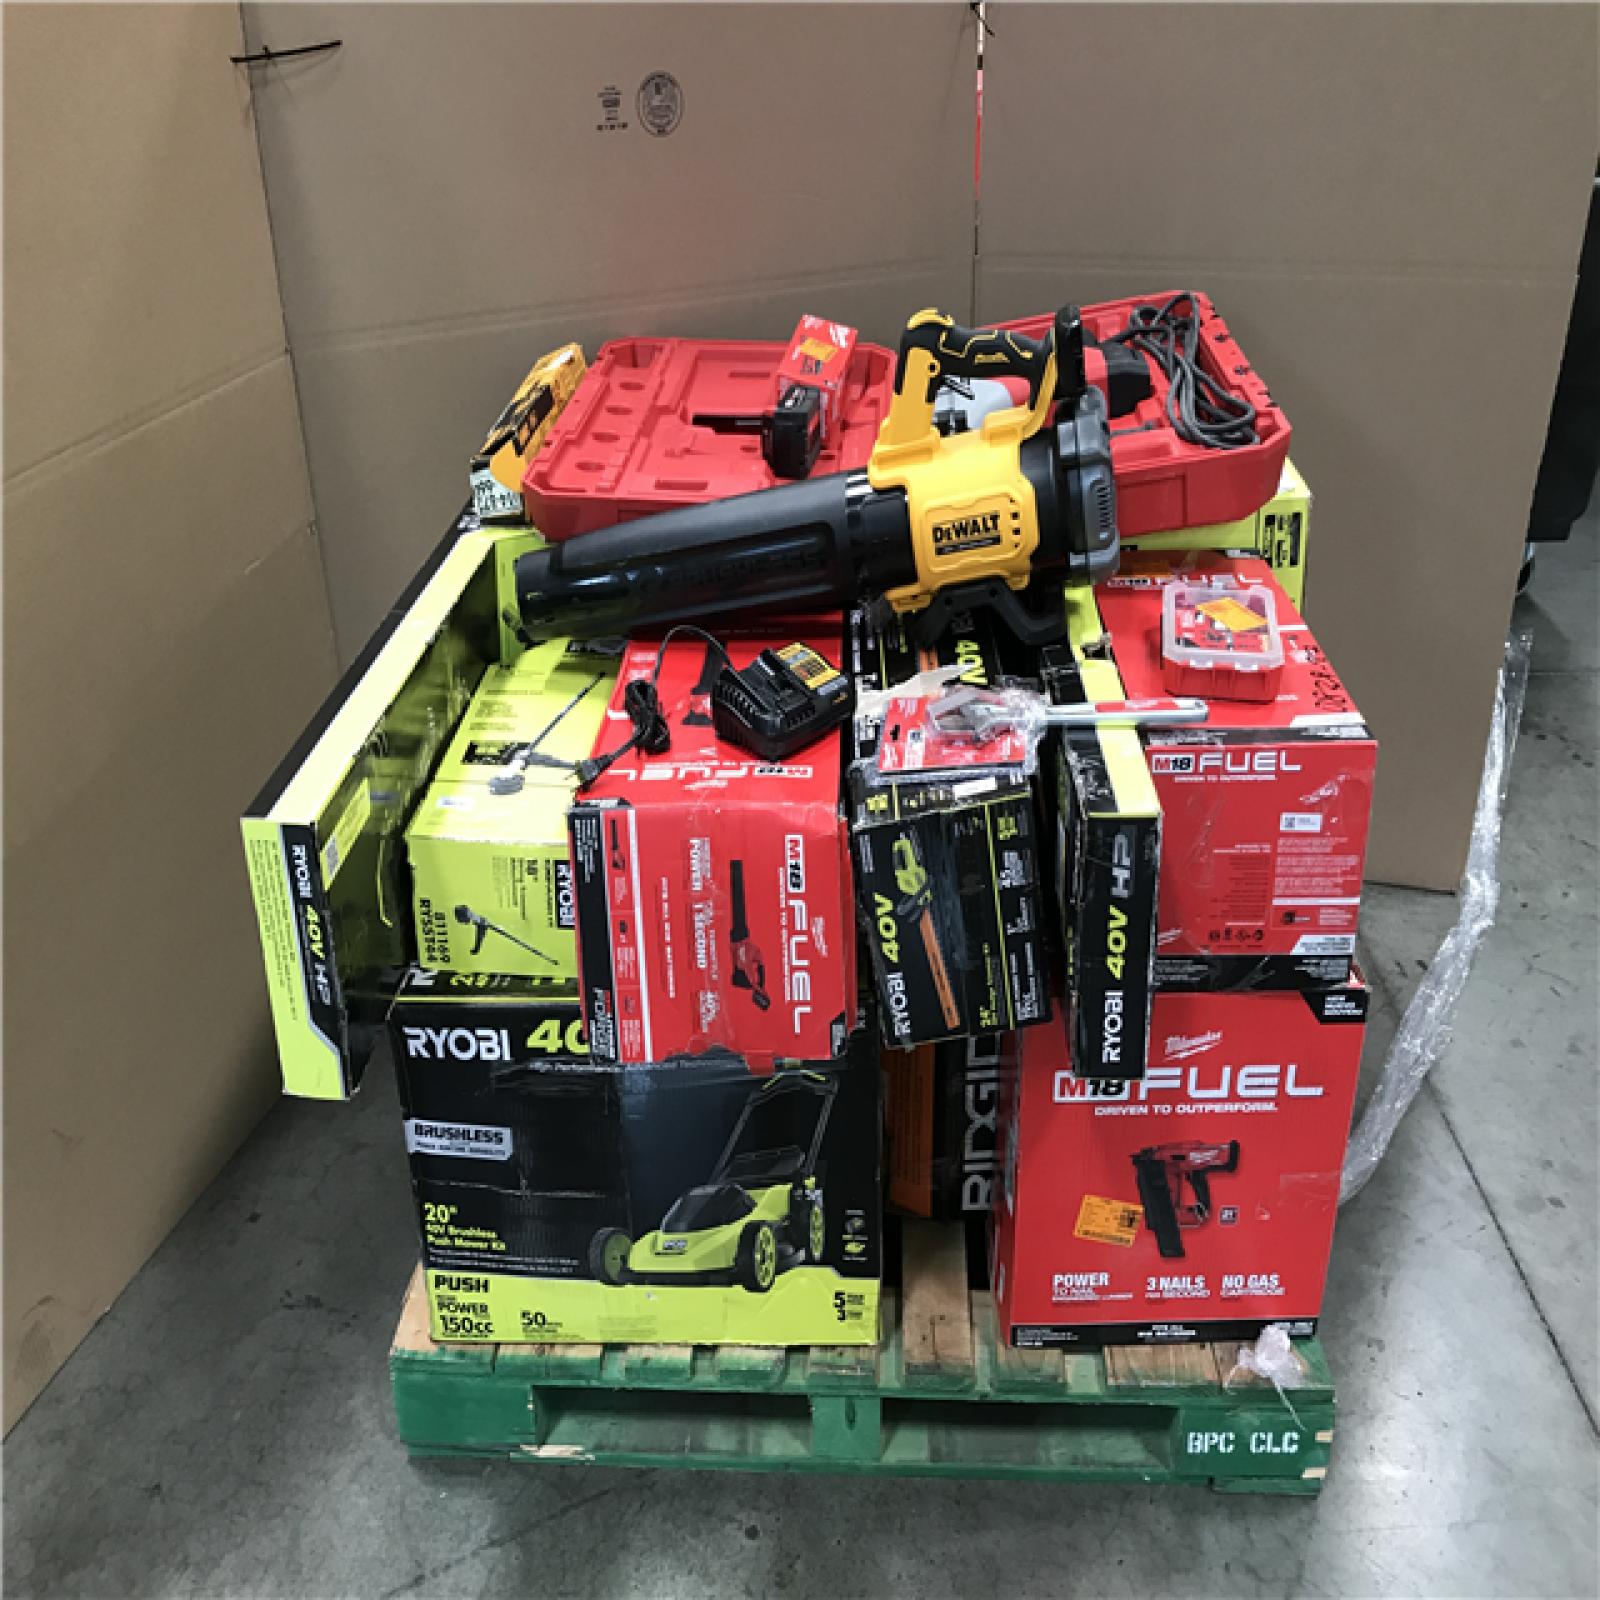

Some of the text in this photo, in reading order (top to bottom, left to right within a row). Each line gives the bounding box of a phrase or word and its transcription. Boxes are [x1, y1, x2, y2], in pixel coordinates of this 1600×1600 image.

[1153, 750, 1302, 772] M18 FUEL
[291, 845, 312, 898] RYOBI
[306, 904, 326, 960] 40V
[1102, 834, 1132, 1063] RYOBI 40V HP
[789, 899, 812, 1035] FUEL
[873, 893, 911, 1036] RYOBI 40V
[403, 1026, 511, 1061] RYOBI
[1057, 1064, 1324, 1100] M18 FUEL
[1152, 1104, 1172, 1115] TO
[414, 1123, 504, 1144] BRUSHLESS
[434, 1274, 490, 1293] PUSH
[1053, 1272, 1110, 1286] POWER
[1146, 1275, 1206, 1291] 3 NAILS
[1222, 1274, 1245, 1289] NO
[440, 1315, 494, 1333] 150cc
[521, 1311, 546, 1326] 50
